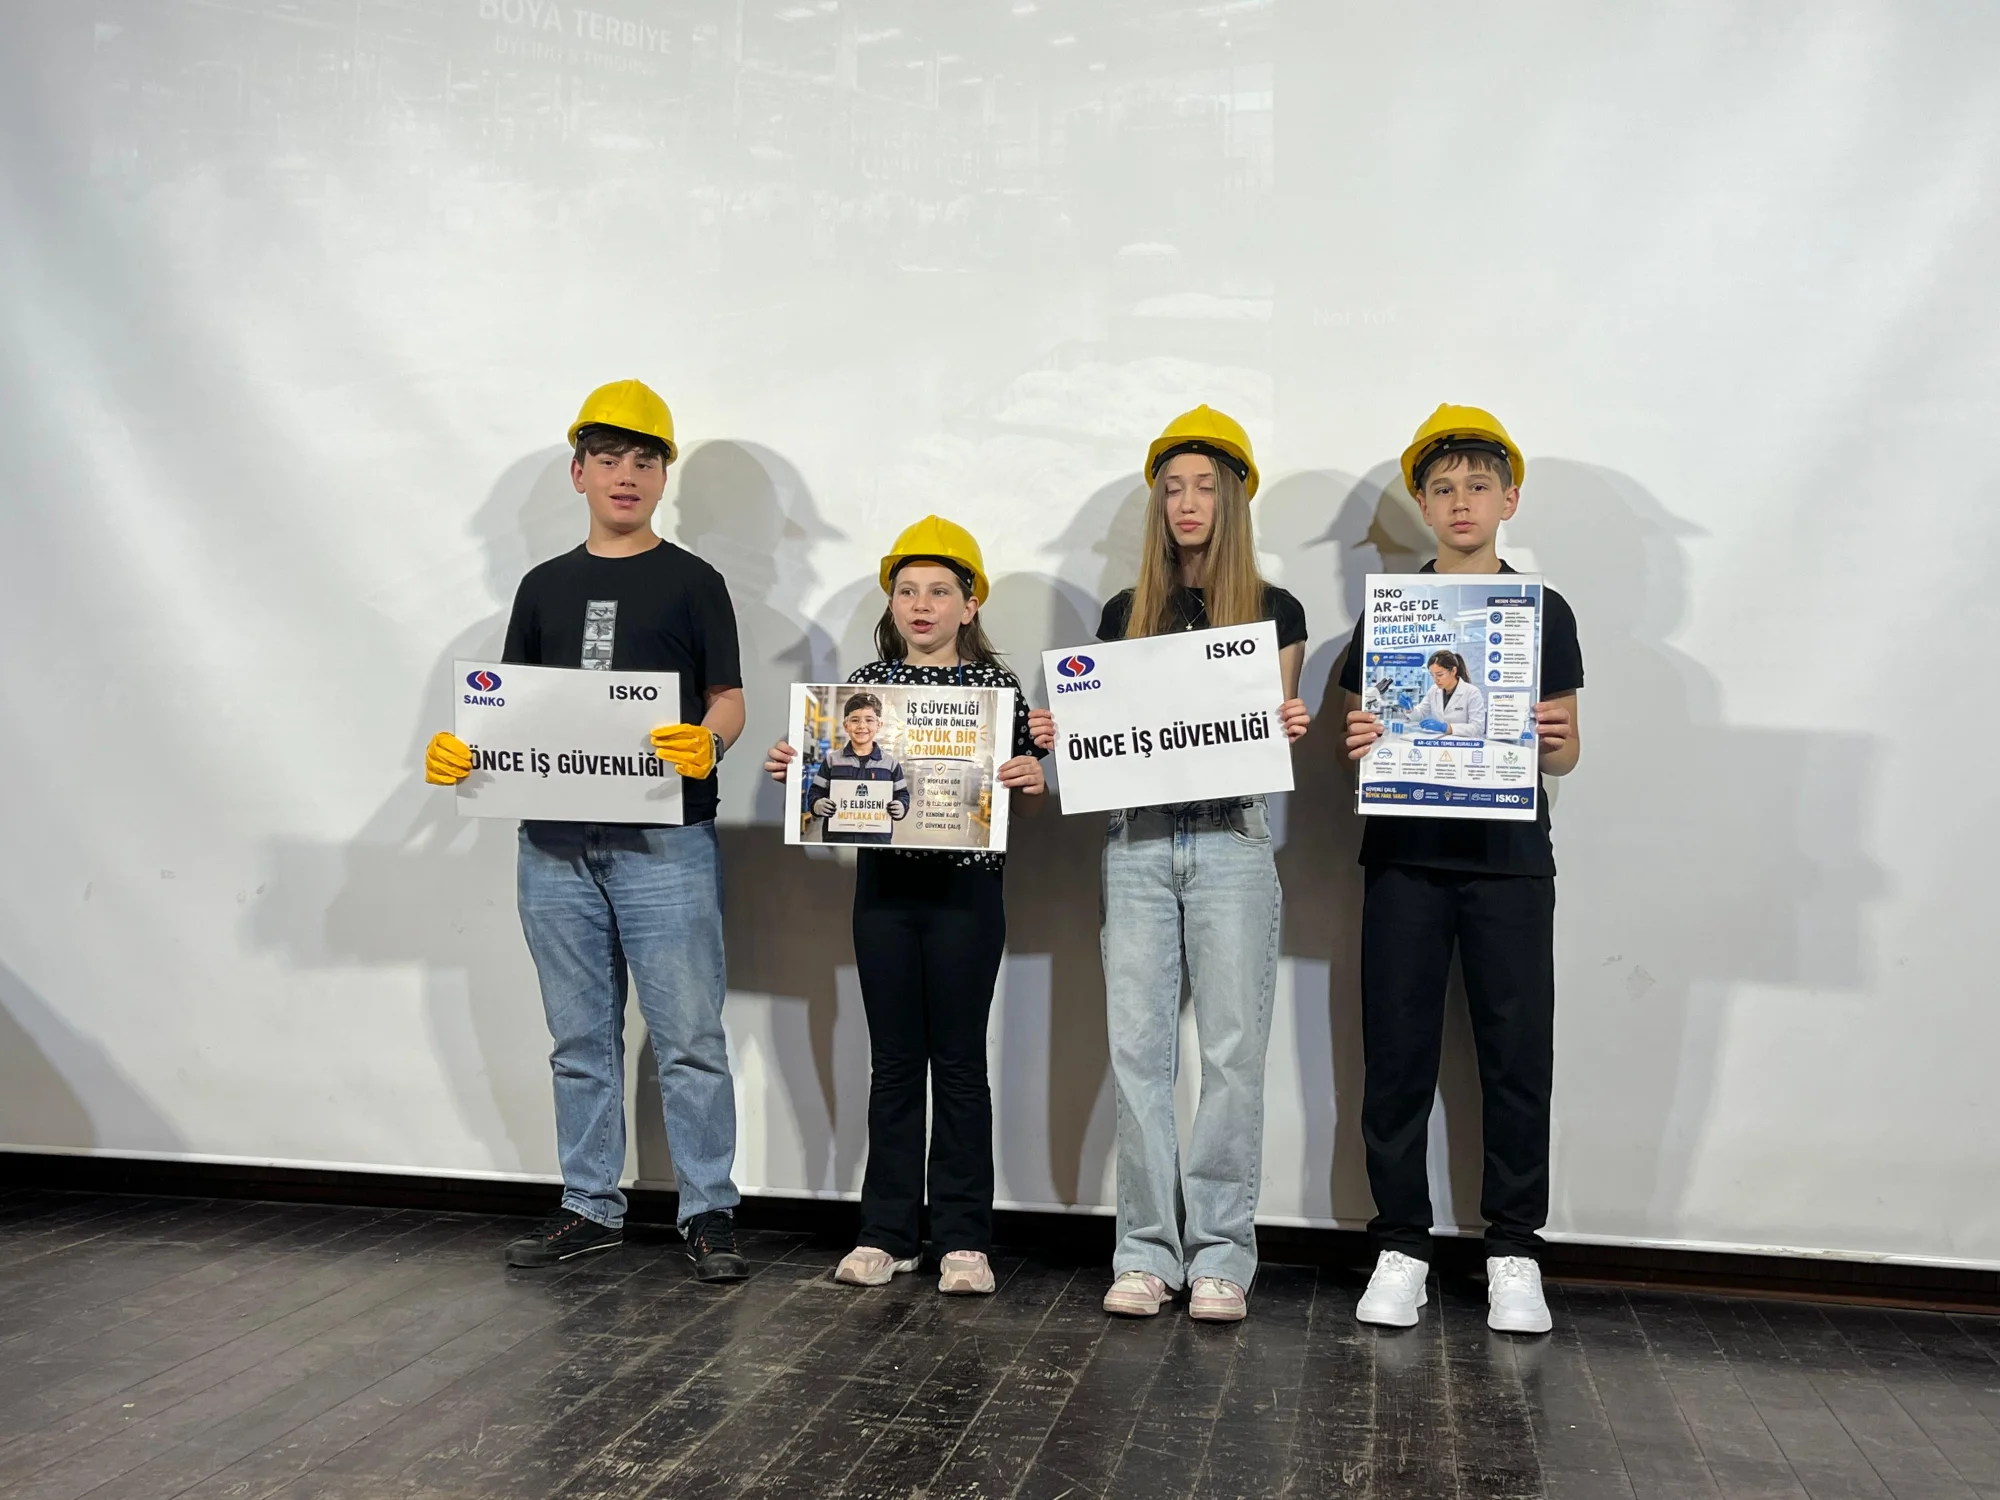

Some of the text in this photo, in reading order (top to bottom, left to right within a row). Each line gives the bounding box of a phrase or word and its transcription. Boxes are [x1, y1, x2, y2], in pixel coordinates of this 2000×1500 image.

[479, 0, 673, 55] BOYA TERBİYE
[1374, 589, 1402, 598] ISKO
[1373, 613, 1446, 623] DİKKATİNİ TOPLA,
[1373, 623, 1436, 635] FİKİRLERİNLE
[1373, 633, 1456, 646] GELECEĞİ YARAT!
[1205, 639, 1256, 660] ISKO
[609, 685, 659, 701] ISKO
[1056, 679, 1101, 694] SANKO
[463, 694, 505, 707] SANKO
[907, 700, 980, 716] İŞ GÜVENLİĞİ
[907, 716, 979, 728] KÜÇÜK BİR ÖNLEM,
[907, 728, 977, 744] BÜYÜK BİR
[1068, 711, 1270, 761] ÖNCE İŞ GÜVENLİĞİ
[469, 744, 664, 778] ÖNCE İŞ GÜVENLİĞİ
[840, 798, 884, 810] İŞ ELBİSENİ
[1495, 794, 1520, 804] ISKO
[837, 811, 872, 820] MUTLAKA
